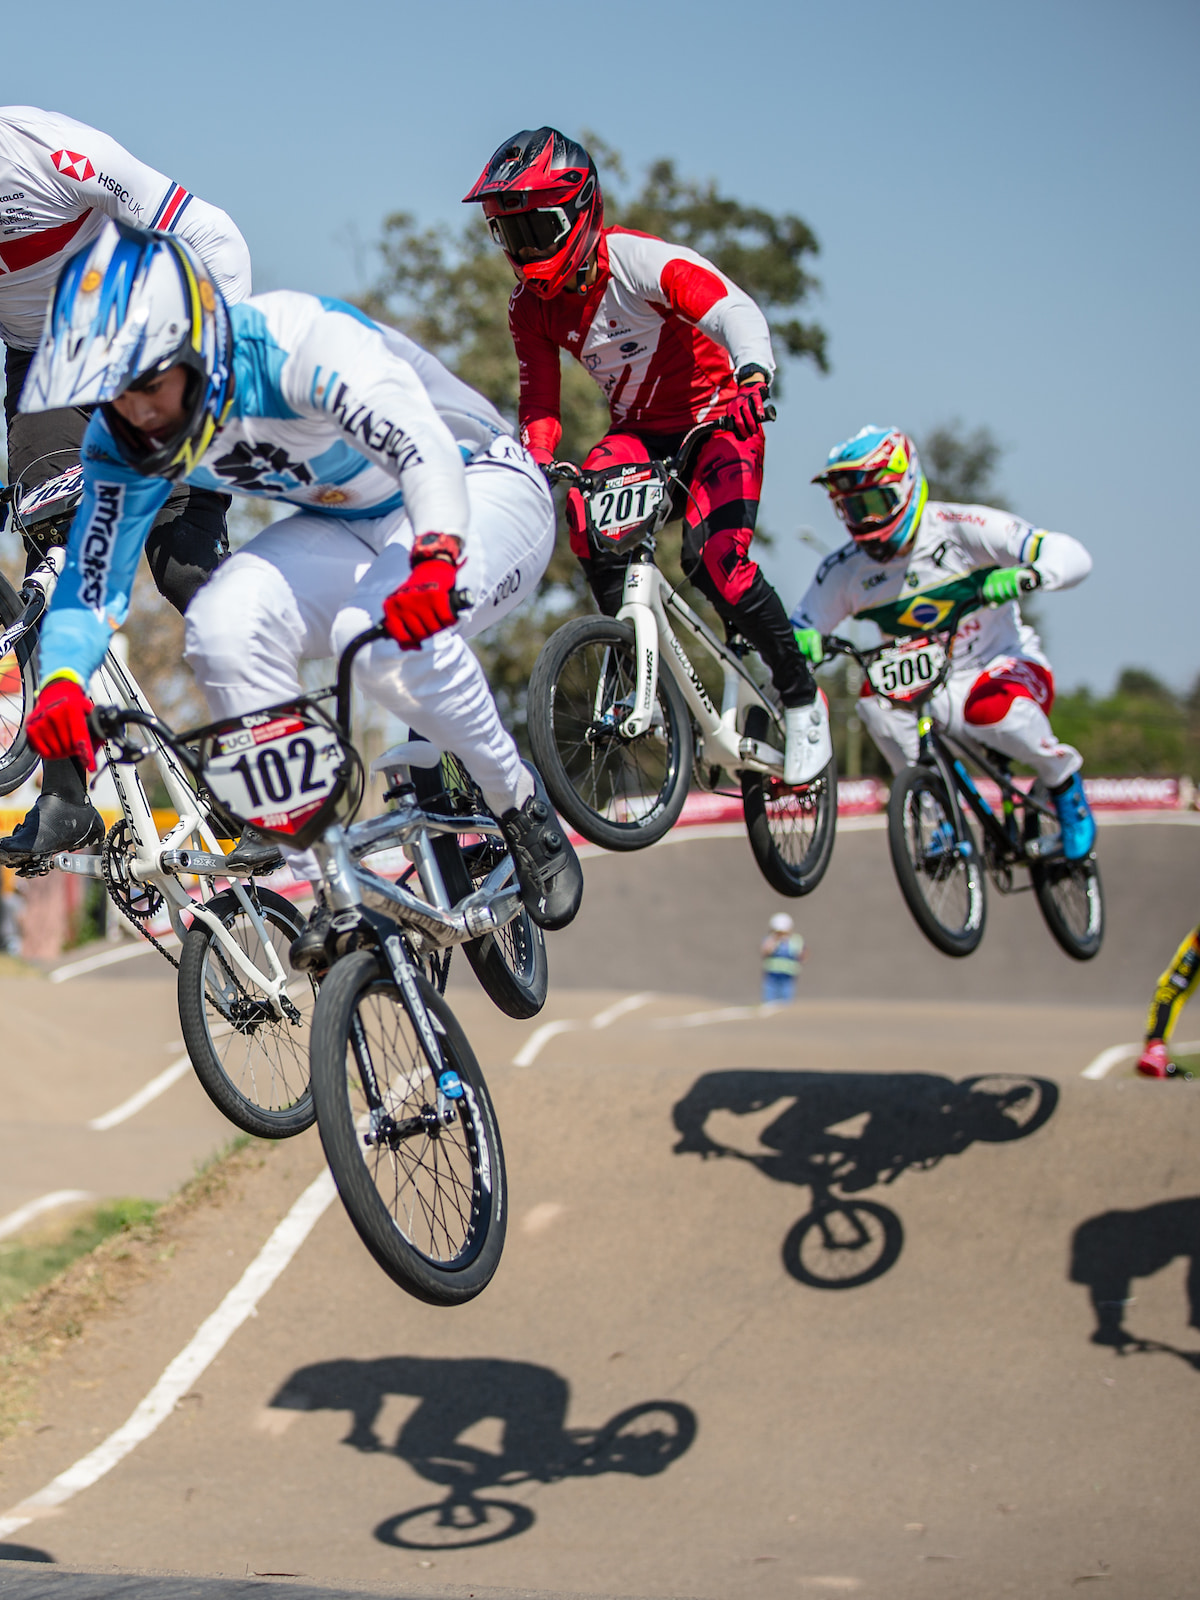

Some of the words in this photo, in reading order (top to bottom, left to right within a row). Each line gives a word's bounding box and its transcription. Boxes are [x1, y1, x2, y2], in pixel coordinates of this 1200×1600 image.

[97, 172, 130, 204] HSBC
[127, 197, 145, 219] UK
[599, 484, 649, 529] 201
[881, 652, 933, 692] 500
[225, 732, 251, 750] UCI
[231, 736, 328, 808] 102
[349, 1012, 381, 1103] ANSWE
